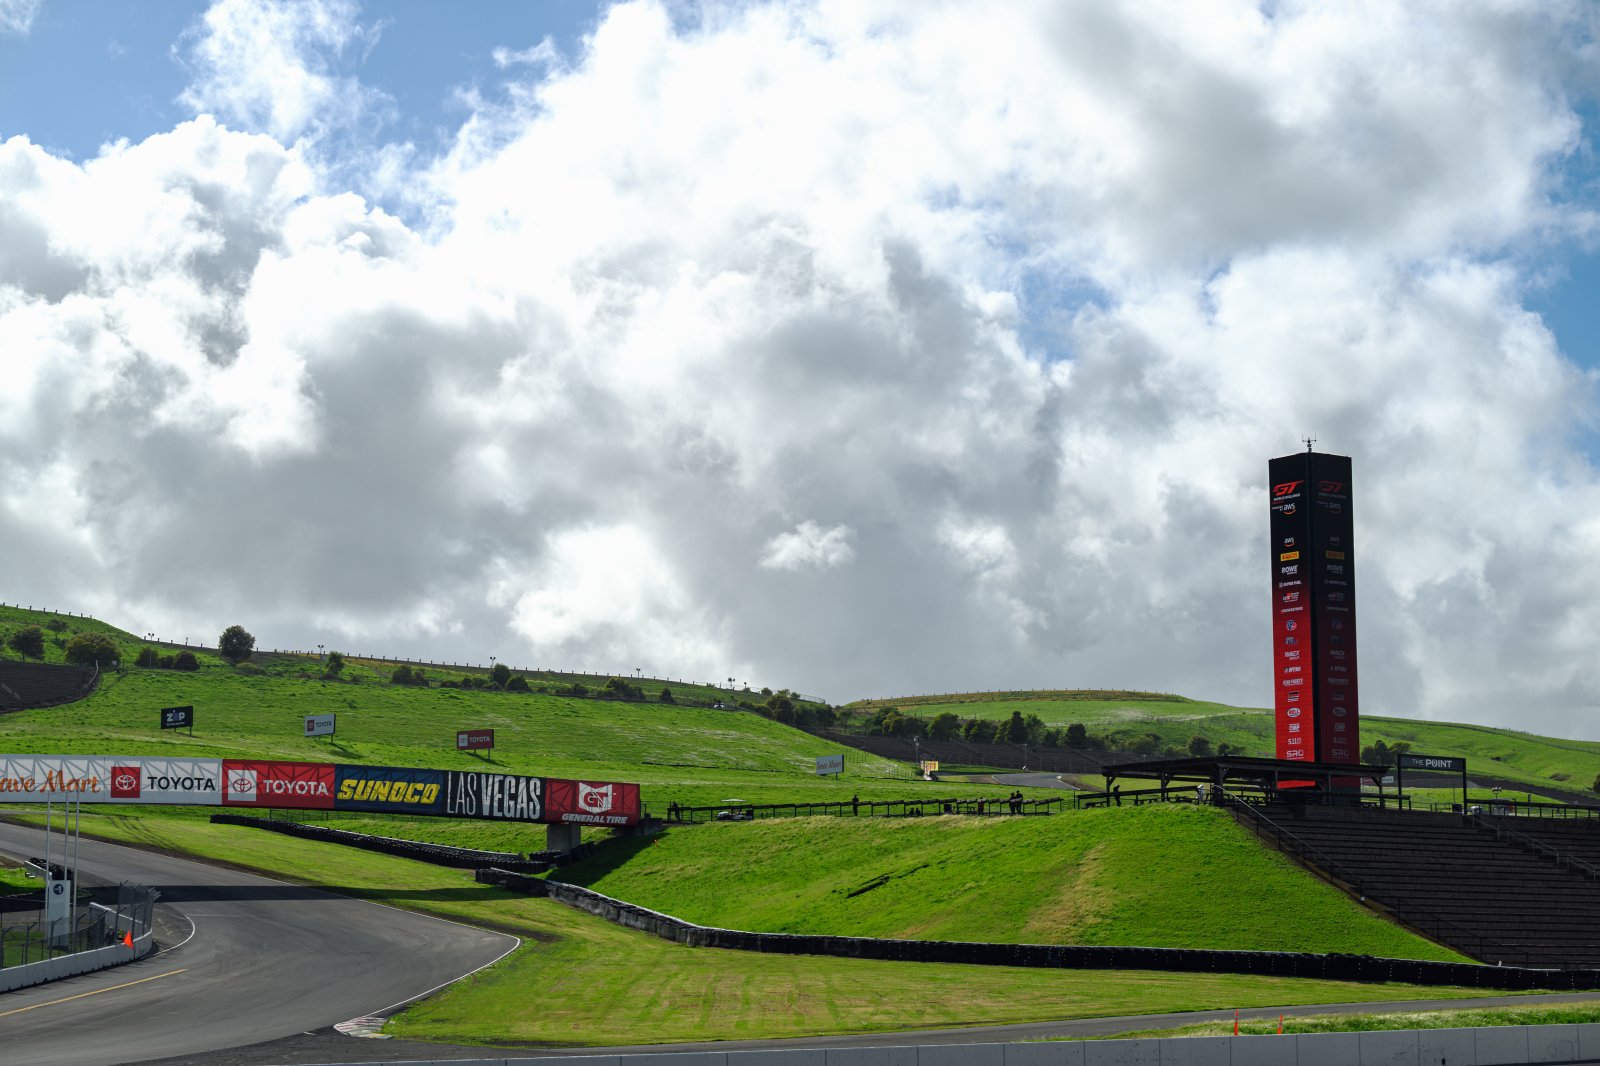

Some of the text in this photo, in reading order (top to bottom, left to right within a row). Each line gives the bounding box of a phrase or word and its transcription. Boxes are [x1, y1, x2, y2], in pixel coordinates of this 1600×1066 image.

[1412, 758, 1452, 768] THE POINT
[0, 768, 101, 793] ave Mart
[147, 776, 216, 791] TOYOTA
[262, 779, 328, 796] TOYOTA
[337, 778, 440, 804] SUNOCO
[447, 771, 541, 819] LAS VEGAS
[561, 813, 628, 825] GENERAL TIRE
